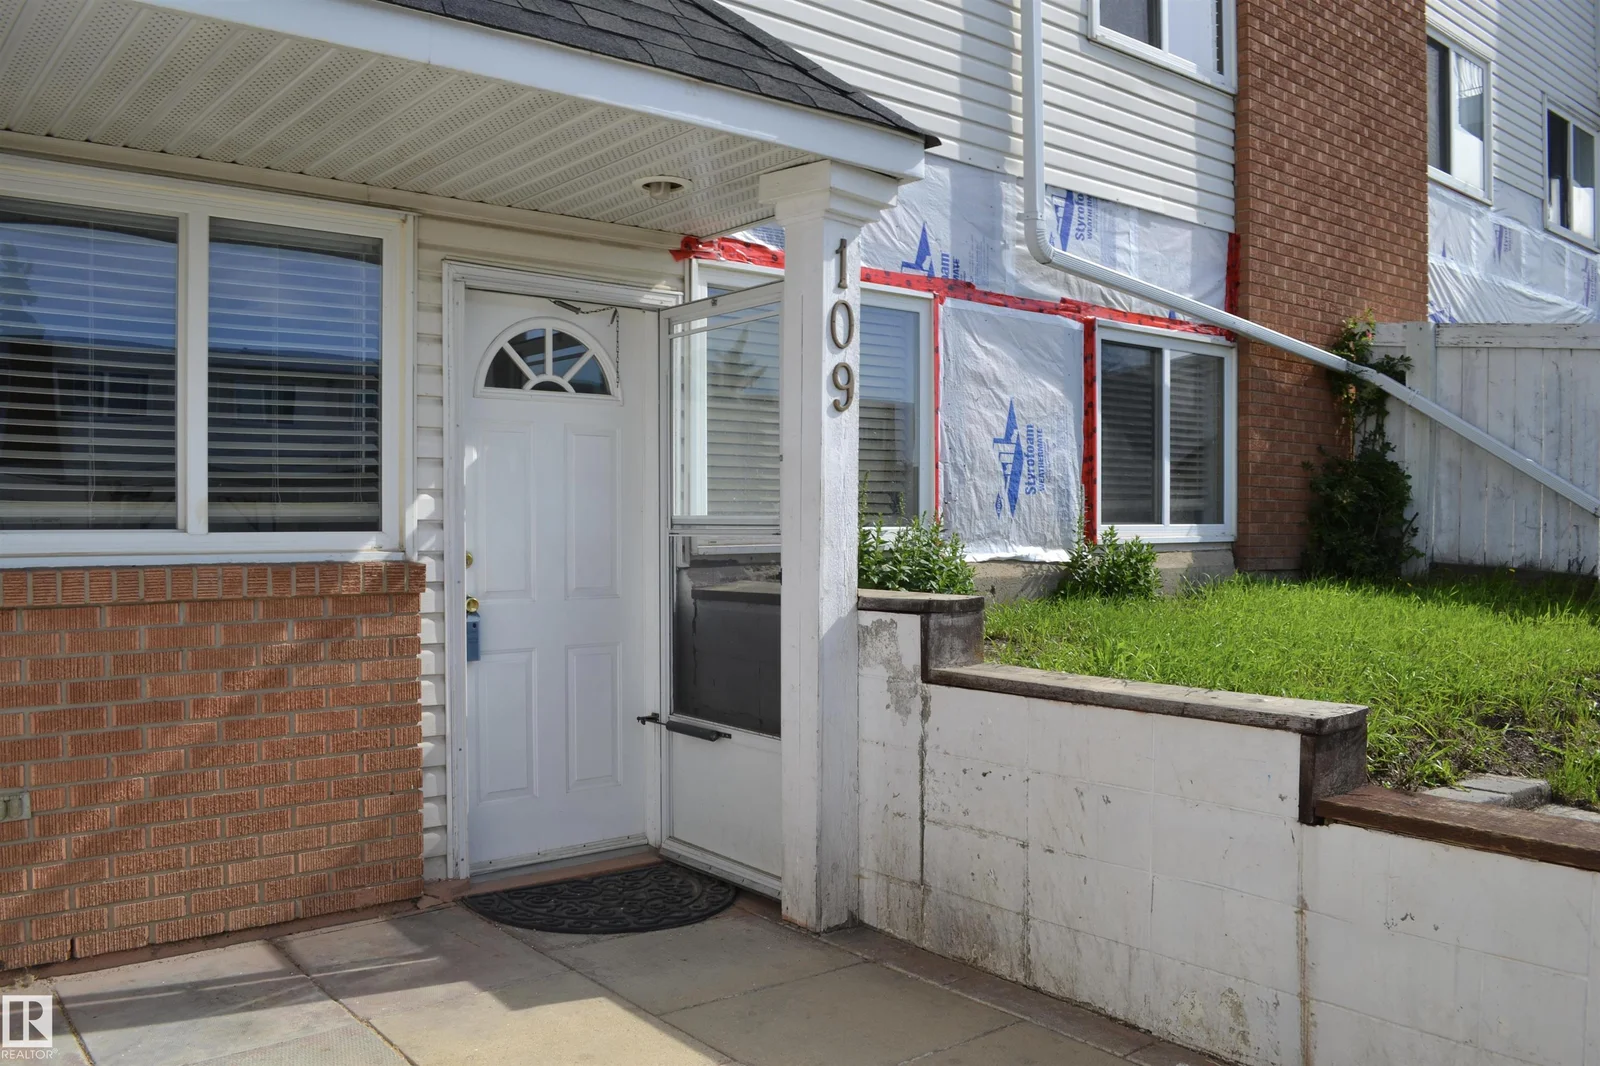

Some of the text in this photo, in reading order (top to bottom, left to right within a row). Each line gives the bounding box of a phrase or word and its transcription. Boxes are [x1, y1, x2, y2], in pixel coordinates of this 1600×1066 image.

[831, 238, 854, 412] 109
[1024, 424, 1037, 495] Styrofoam
[1036, 428, 1045, 492] WEATHERMATE
